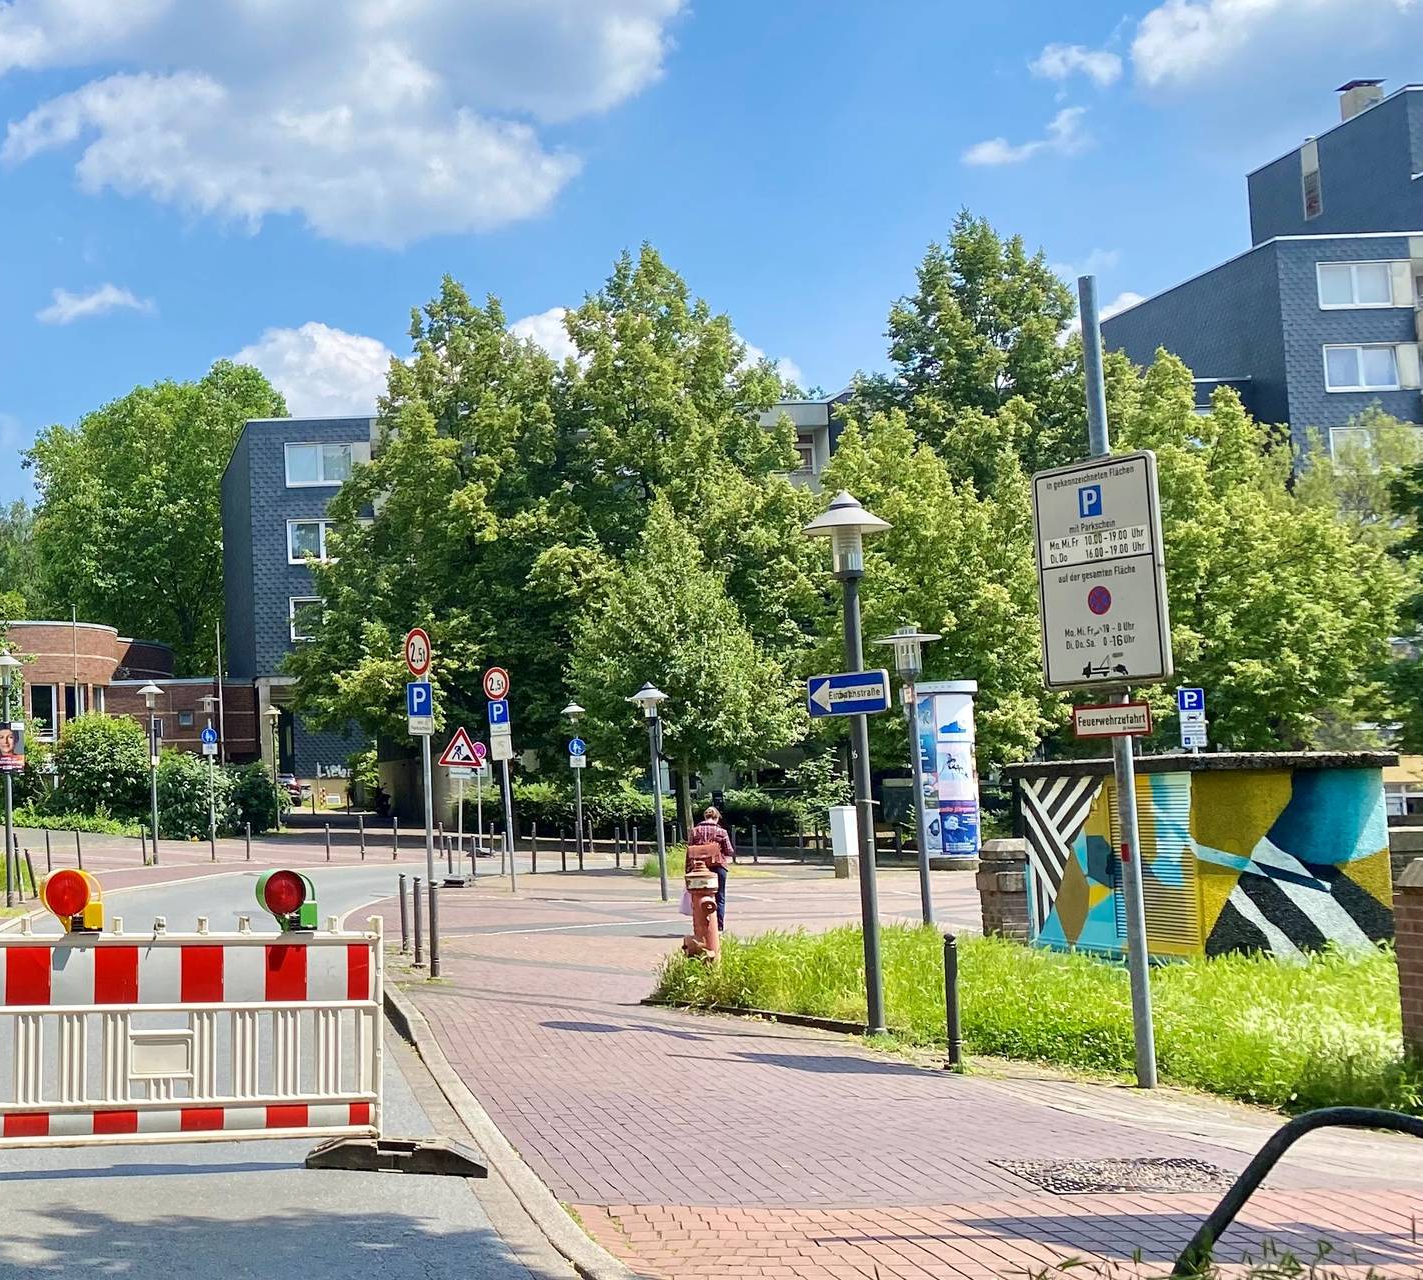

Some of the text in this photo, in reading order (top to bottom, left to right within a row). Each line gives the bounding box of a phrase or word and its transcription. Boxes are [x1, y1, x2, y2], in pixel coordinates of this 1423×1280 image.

[1109, 466, 1135, 478] Flächen
[1082, 489, 1097, 515] P
[1068, 520, 1116, 534] mit Parkschein
[1132, 528, 1144, 538] Uhr
[1132, 542, 1145, 552] Uhr
[1058, 564, 1136, 583] auf der gesamten Fläche
[1123, 621, 1135, 631] Uhr
[1124, 634, 1136, 644] Uhr
[413, 687, 426, 713] P
[1184, 691, 1198, 708] P
[492, 703, 504, 722] P
[1078, 713, 1146, 728] Feuerwehrzufahrt
